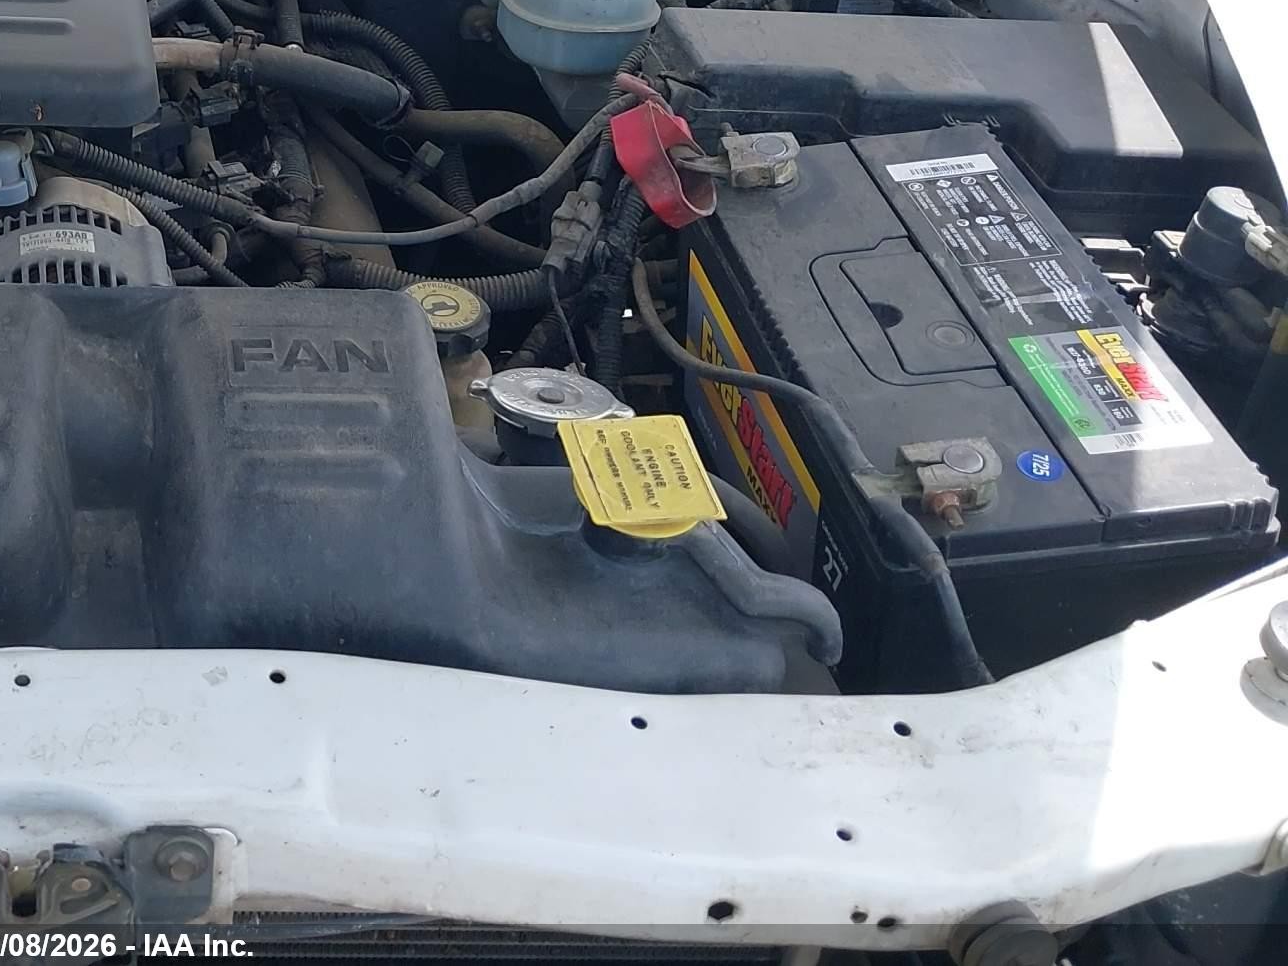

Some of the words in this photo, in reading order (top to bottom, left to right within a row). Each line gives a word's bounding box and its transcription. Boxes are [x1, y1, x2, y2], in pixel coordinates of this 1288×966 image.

[230, 338, 393, 373] FAN
[620, 430, 647, 476] COOLANT
[643, 481, 661, 509] ONLY
[641, 448, 667, 489] ENGINE
[665, 444, 692, 490] CAUTION
[822, 545, 843, 592] 27
